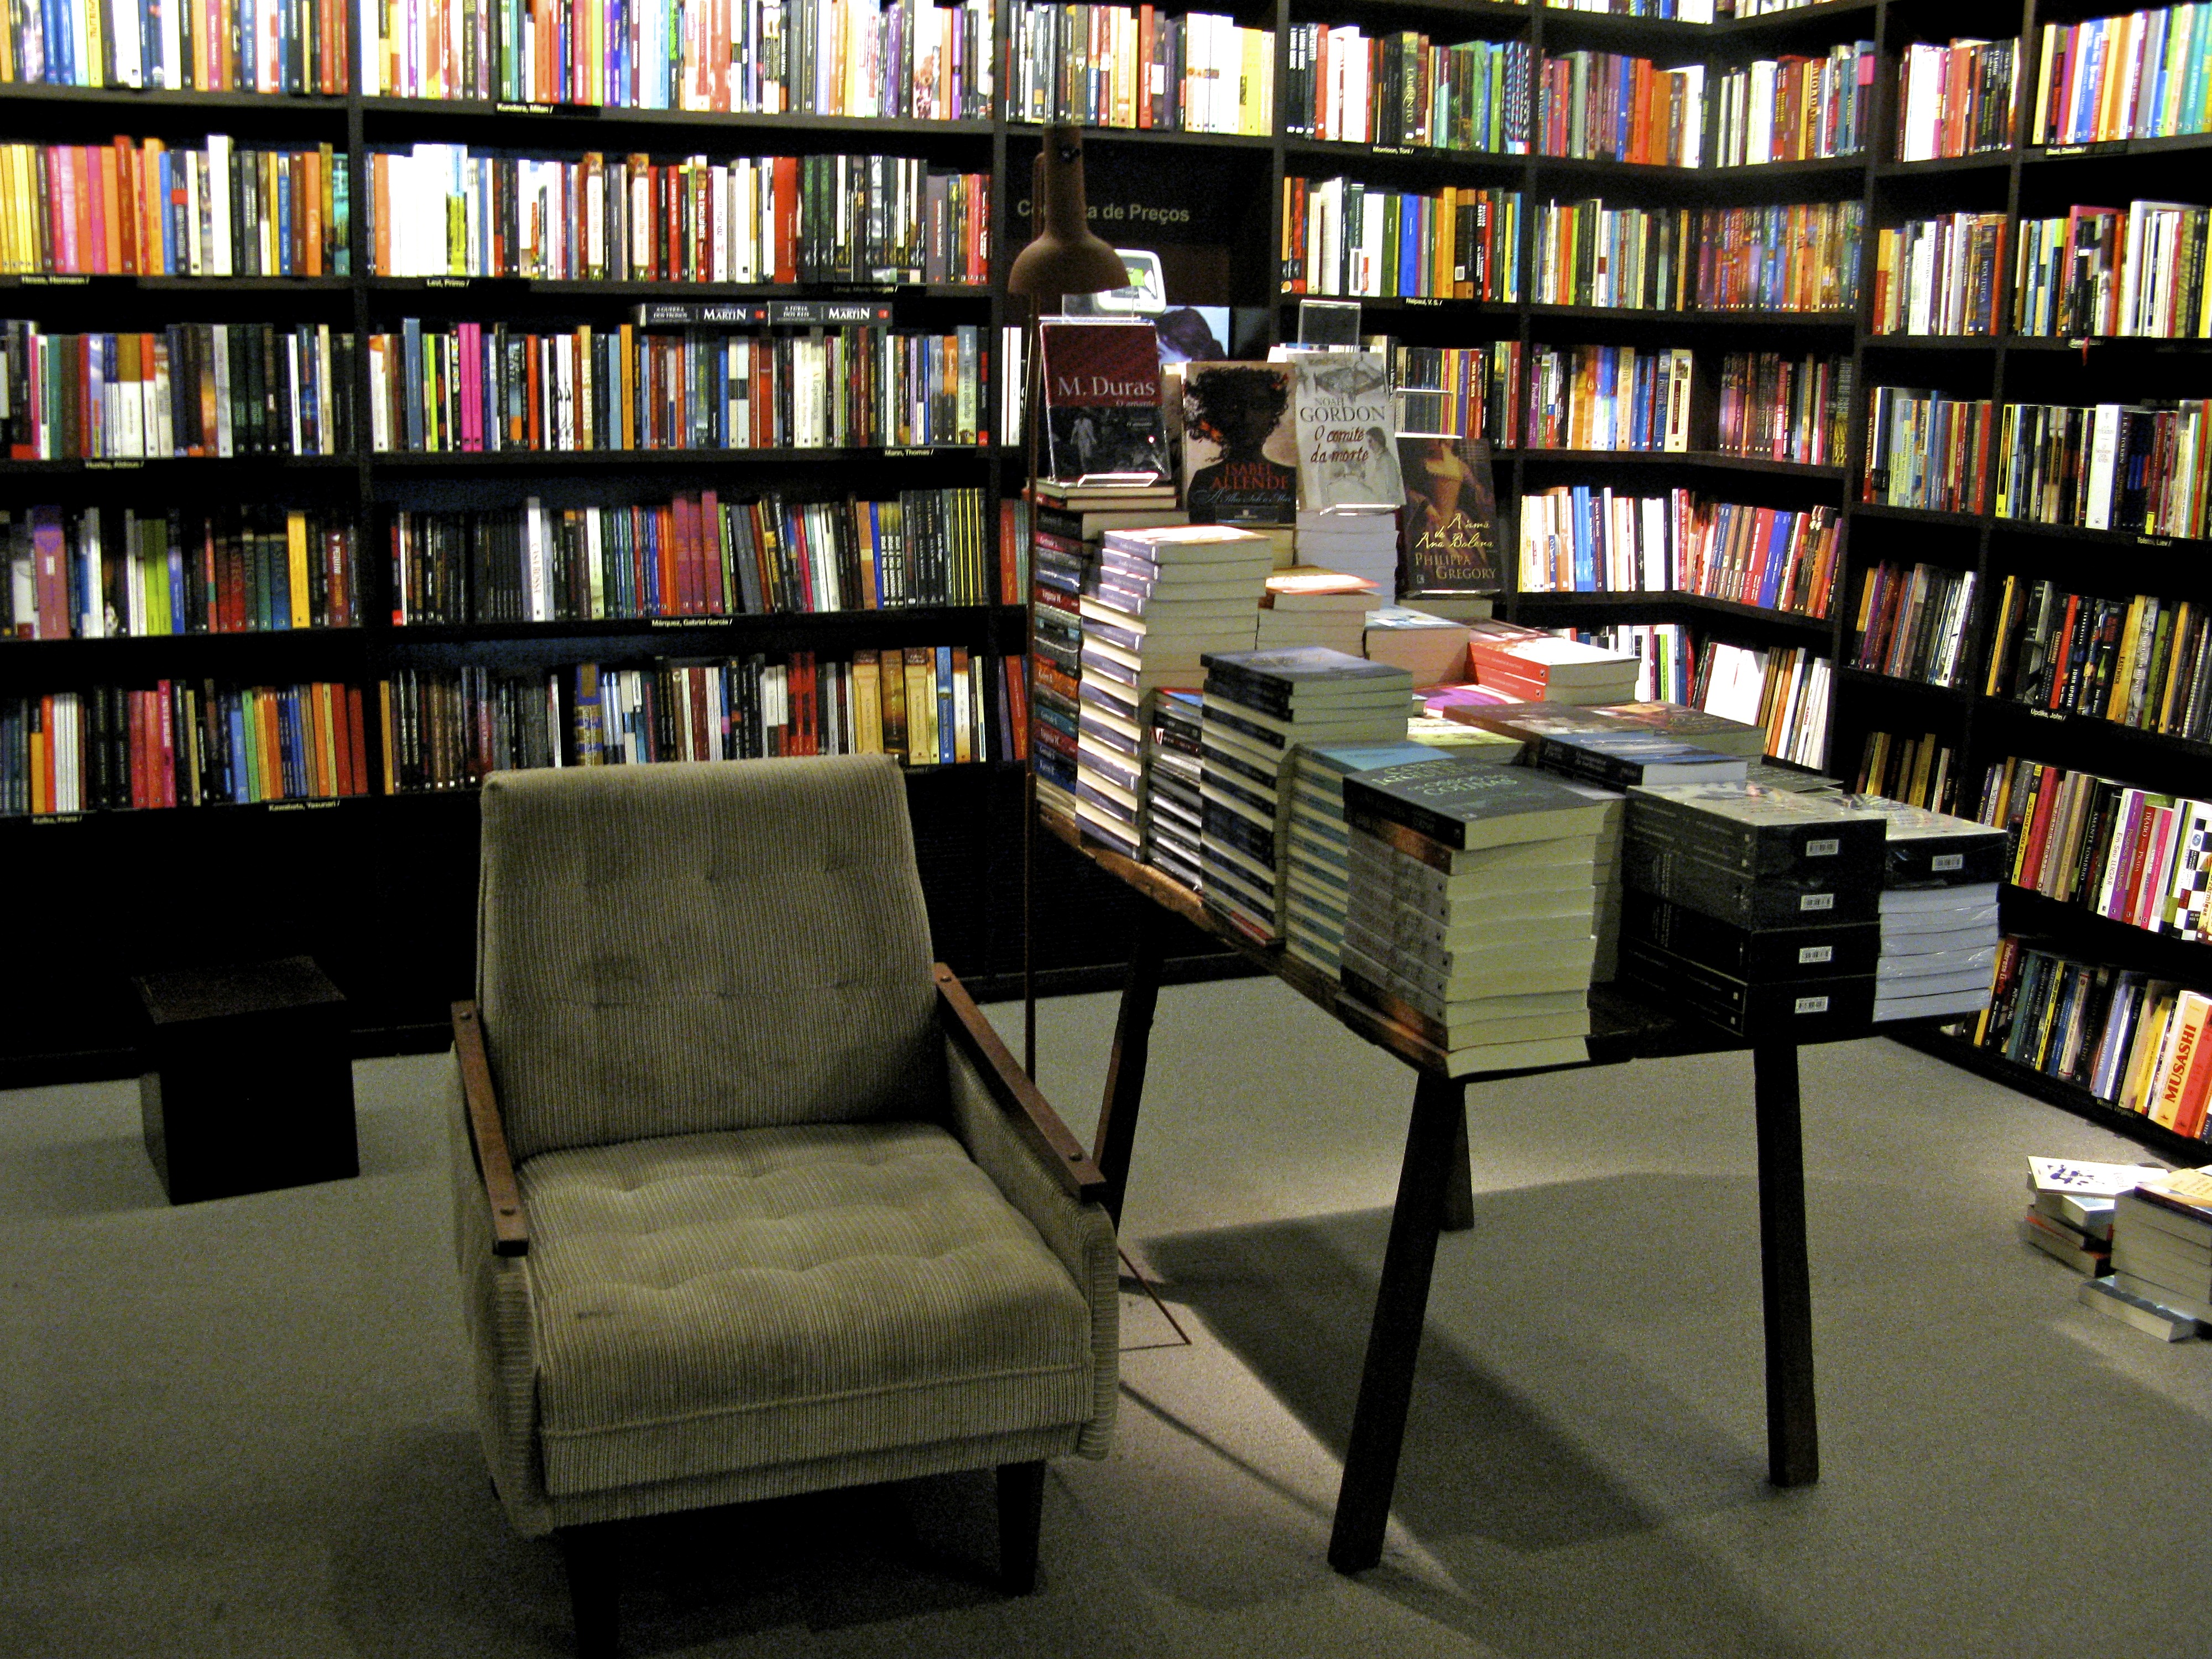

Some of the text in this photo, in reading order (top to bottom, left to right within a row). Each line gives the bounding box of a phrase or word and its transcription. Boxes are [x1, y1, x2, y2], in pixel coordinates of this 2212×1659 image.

[1403, 66, 1415, 123] LABIRINTO
[1373, 147, 1399, 155] Morrison,
[1103, 204, 1124, 220] de
[1130, 204, 1190, 225] Preços
[1979, 260, 1989, 302] BOUDICA
[703, 307, 747, 321] MARTIN
[828, 306, 871, 320] MARTIN
[1057, 377, 1155, 396] M. Duras
[1300, 405, 1385, 422] GORDON
[1314, 425, 1325, 441] O
[885, 449, 930, 458] Mann, Thomas
[1310, 443, 1369, 463] da morte
[1224, 462, 1274, 476] ISABEL
[1209, 474, 1288, 489] ALLENDE
[1447, 513, 1462, 530] A
[1415, 531, 1494, 550] Ana Bolena
[1434, 525, 1446, 539] de
[1415, 552, 1472, 566] PHILIPPA
[1436, 566, 1496, 581] GREGORY
[651, 618, 682, 628] Márquez,
[683, 618, 706, 626] Gabriel
[2066, 612, 2088, 707] TERRORISTA JOHN UPDIKE
[2114, 656, 2125, 685] EASTWICK
[2031, 708, 2063, 720] Updike, John
[2023, 811, 2032, 827] TIME
[2079, 811, 2098, 881] AMANTE SOMBRIO
[2106, 832, 2122, 885] Em Seu LUGAR
[2133, 851, 2145, 873] PRADA
[2164, 1024, 2197, 1103] MUSASHI
